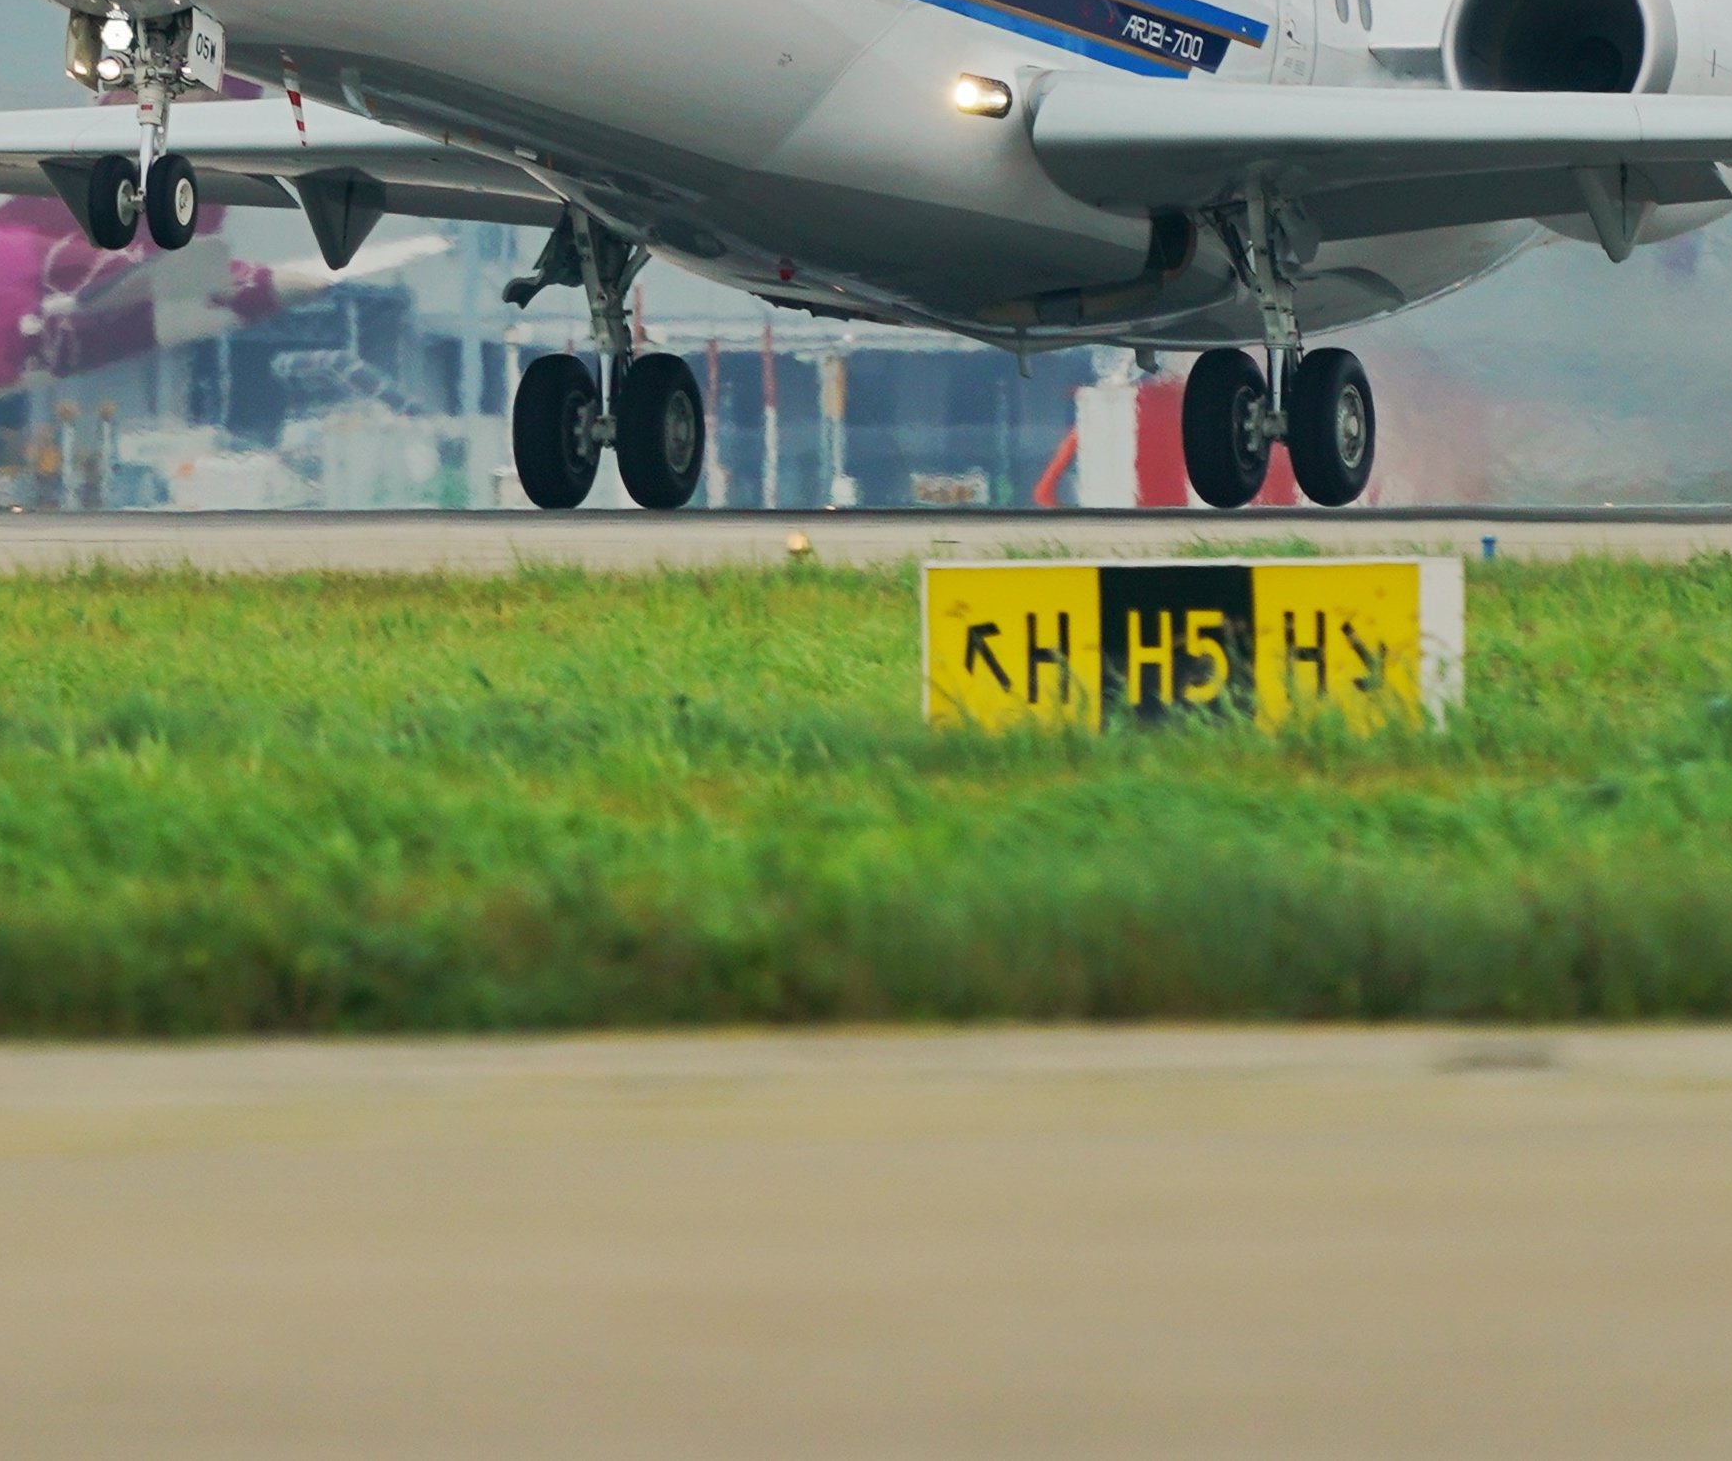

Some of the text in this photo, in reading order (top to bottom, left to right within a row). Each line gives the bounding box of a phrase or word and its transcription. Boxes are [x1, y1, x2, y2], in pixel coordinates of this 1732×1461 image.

[1121, 14, 1204, 62] ARJ21-700
[1026, 609, 1326, 705] H H5 H
